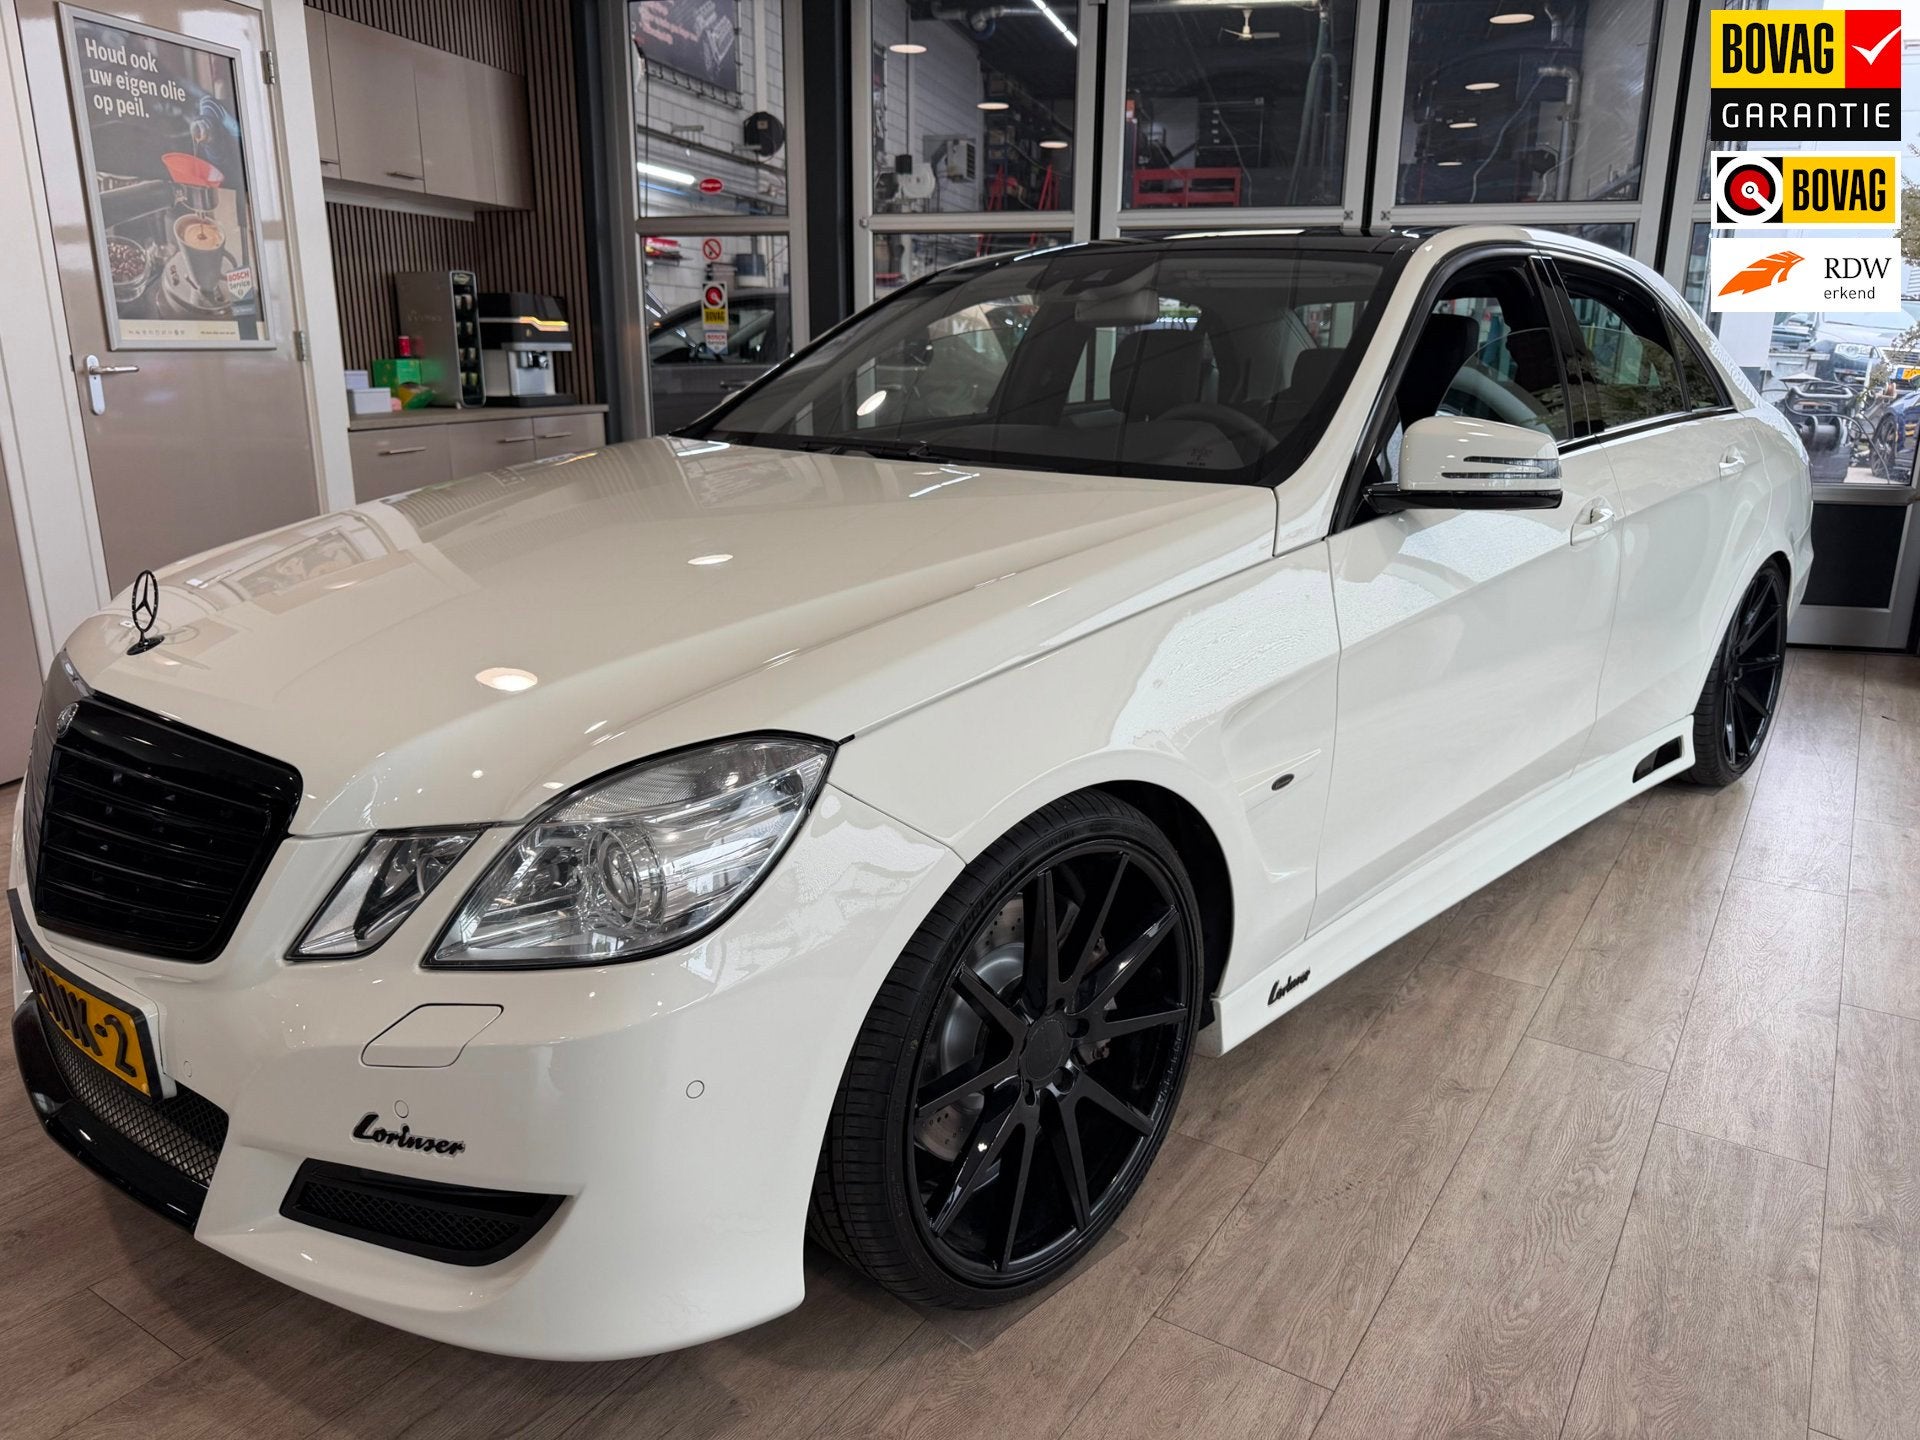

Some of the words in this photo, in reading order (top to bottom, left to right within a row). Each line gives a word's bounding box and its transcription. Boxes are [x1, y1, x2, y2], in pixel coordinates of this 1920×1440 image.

[84, 37, 127, 66] Houd
[130, 51, 158, 73] ook
[89, 68, 112, 87] uw
[115, 71, 158, 97] eigen
[160, 80, 186, 102] olie
[93, 94, 114, 116] op
[116, 97, 150, 119] peil.
[228, 271, 250, 282] BOSCH
[705, 311, 725, 322] BOVAG
[352, 1112, 466, 1156] Lorinser
